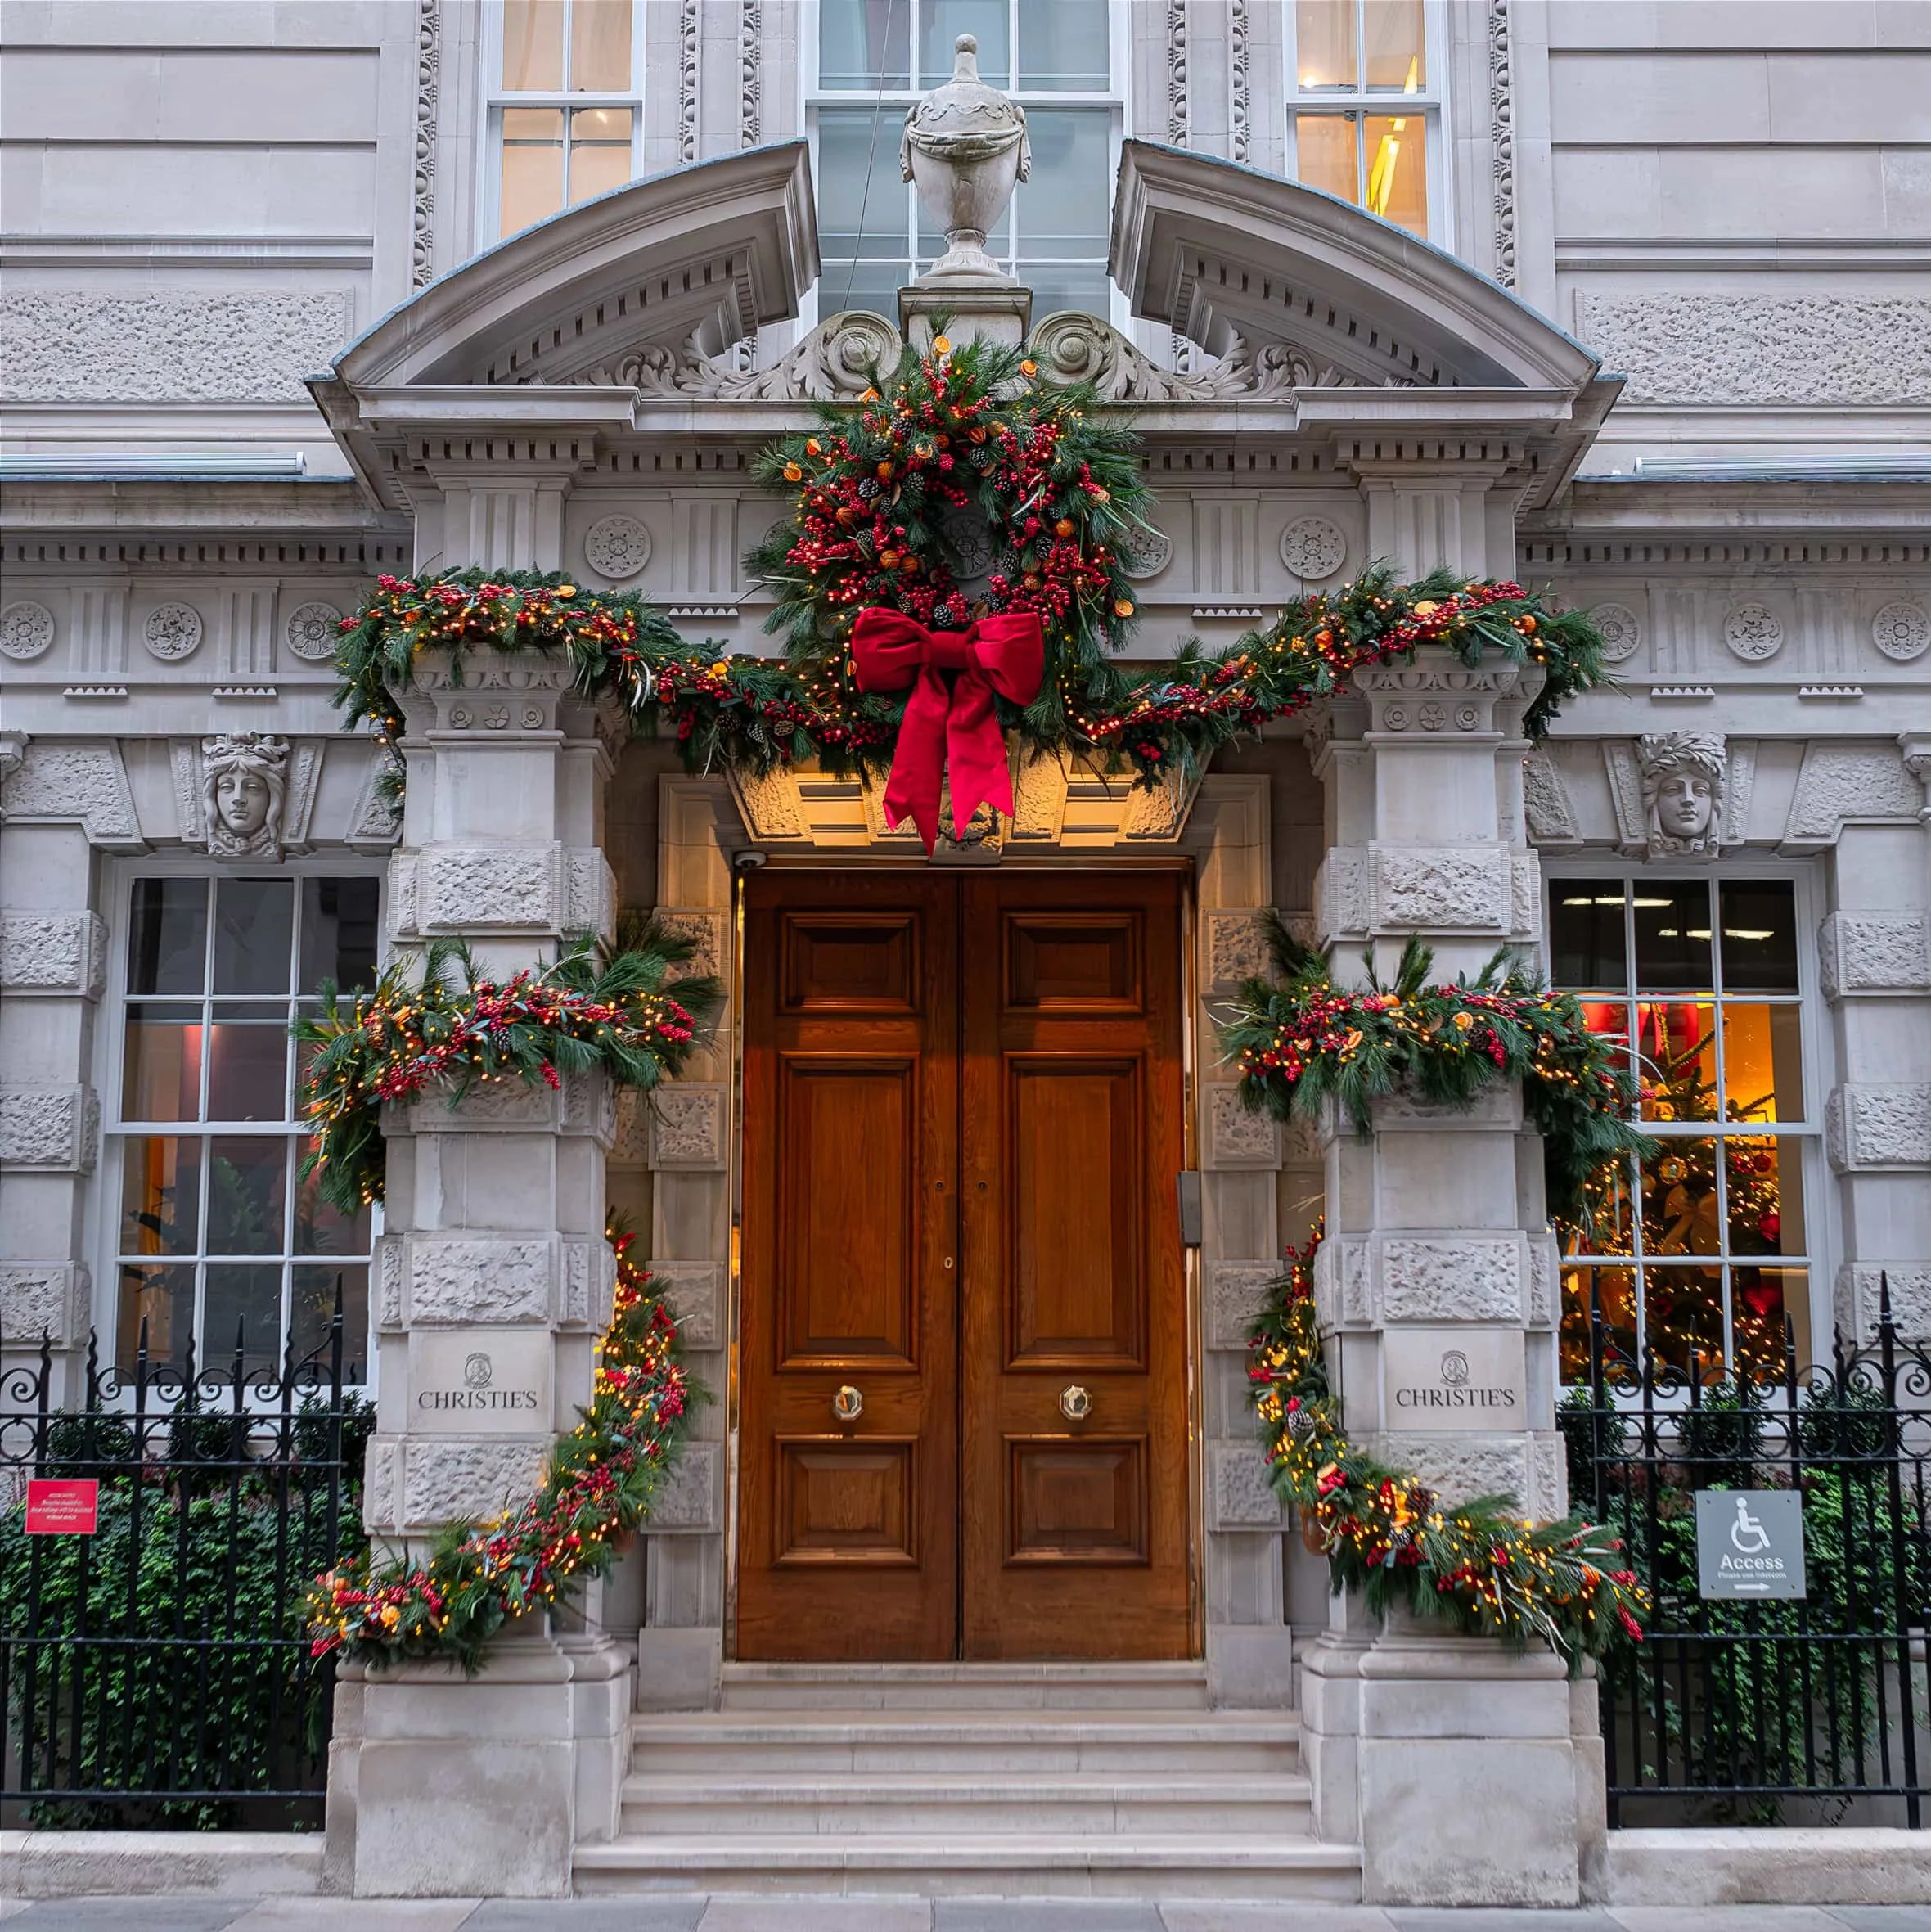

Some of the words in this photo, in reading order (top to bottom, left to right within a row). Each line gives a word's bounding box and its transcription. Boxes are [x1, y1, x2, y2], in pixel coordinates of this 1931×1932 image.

[418, 1390, 538, 1410] CHRISTIE'S
[1396, 1388, 1515, 1407] CHRISTIE'S
[1720, 1553, 1784, 1570] Access
